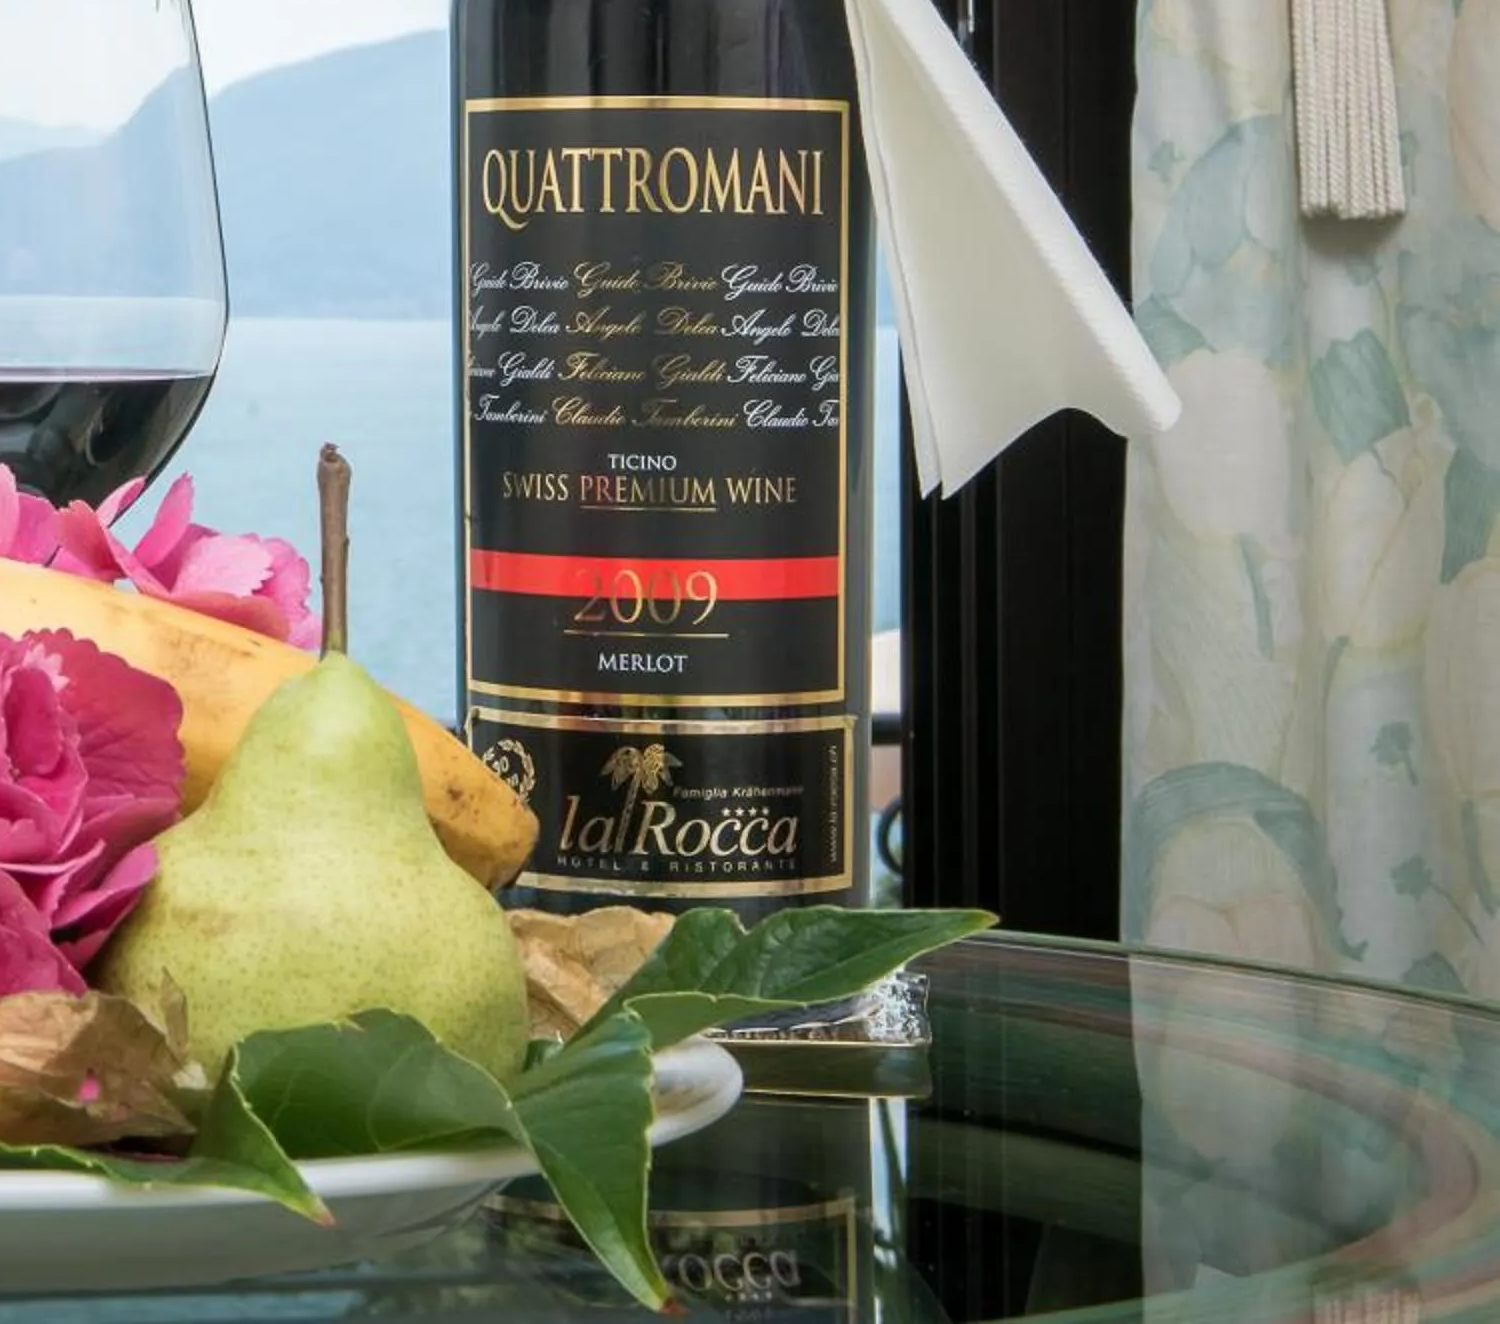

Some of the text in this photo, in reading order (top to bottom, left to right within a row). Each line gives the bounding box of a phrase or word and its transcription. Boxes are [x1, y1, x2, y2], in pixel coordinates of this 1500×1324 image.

[482, 147, 825, 230] QUATTROMANI
[509, 260, 569, 291] Brivio
[573, 261, 641, 299] Guido
[644, 260, 718, 292] Brivio
[721, 262, 783, 301] Guido
[566, 306, 647, 343] Angelo
[721, 308, 796, 347] Angelo
[727, 355, 807, 384] Feliciano
[552, 396, 627, 427] Claudio
[743, 398, 810, 428] Claudio
[607, 453, 678, 471] TICINO
[503, 472, 798, 505] SWISS PREMIUM WINE
[573, 567, 719, 626] 2009
[598, 652, 689, 674] MERLOT
[557, 855, 621, 872] HOTEL
[669, 859, 797, 874] RISTORANTE
